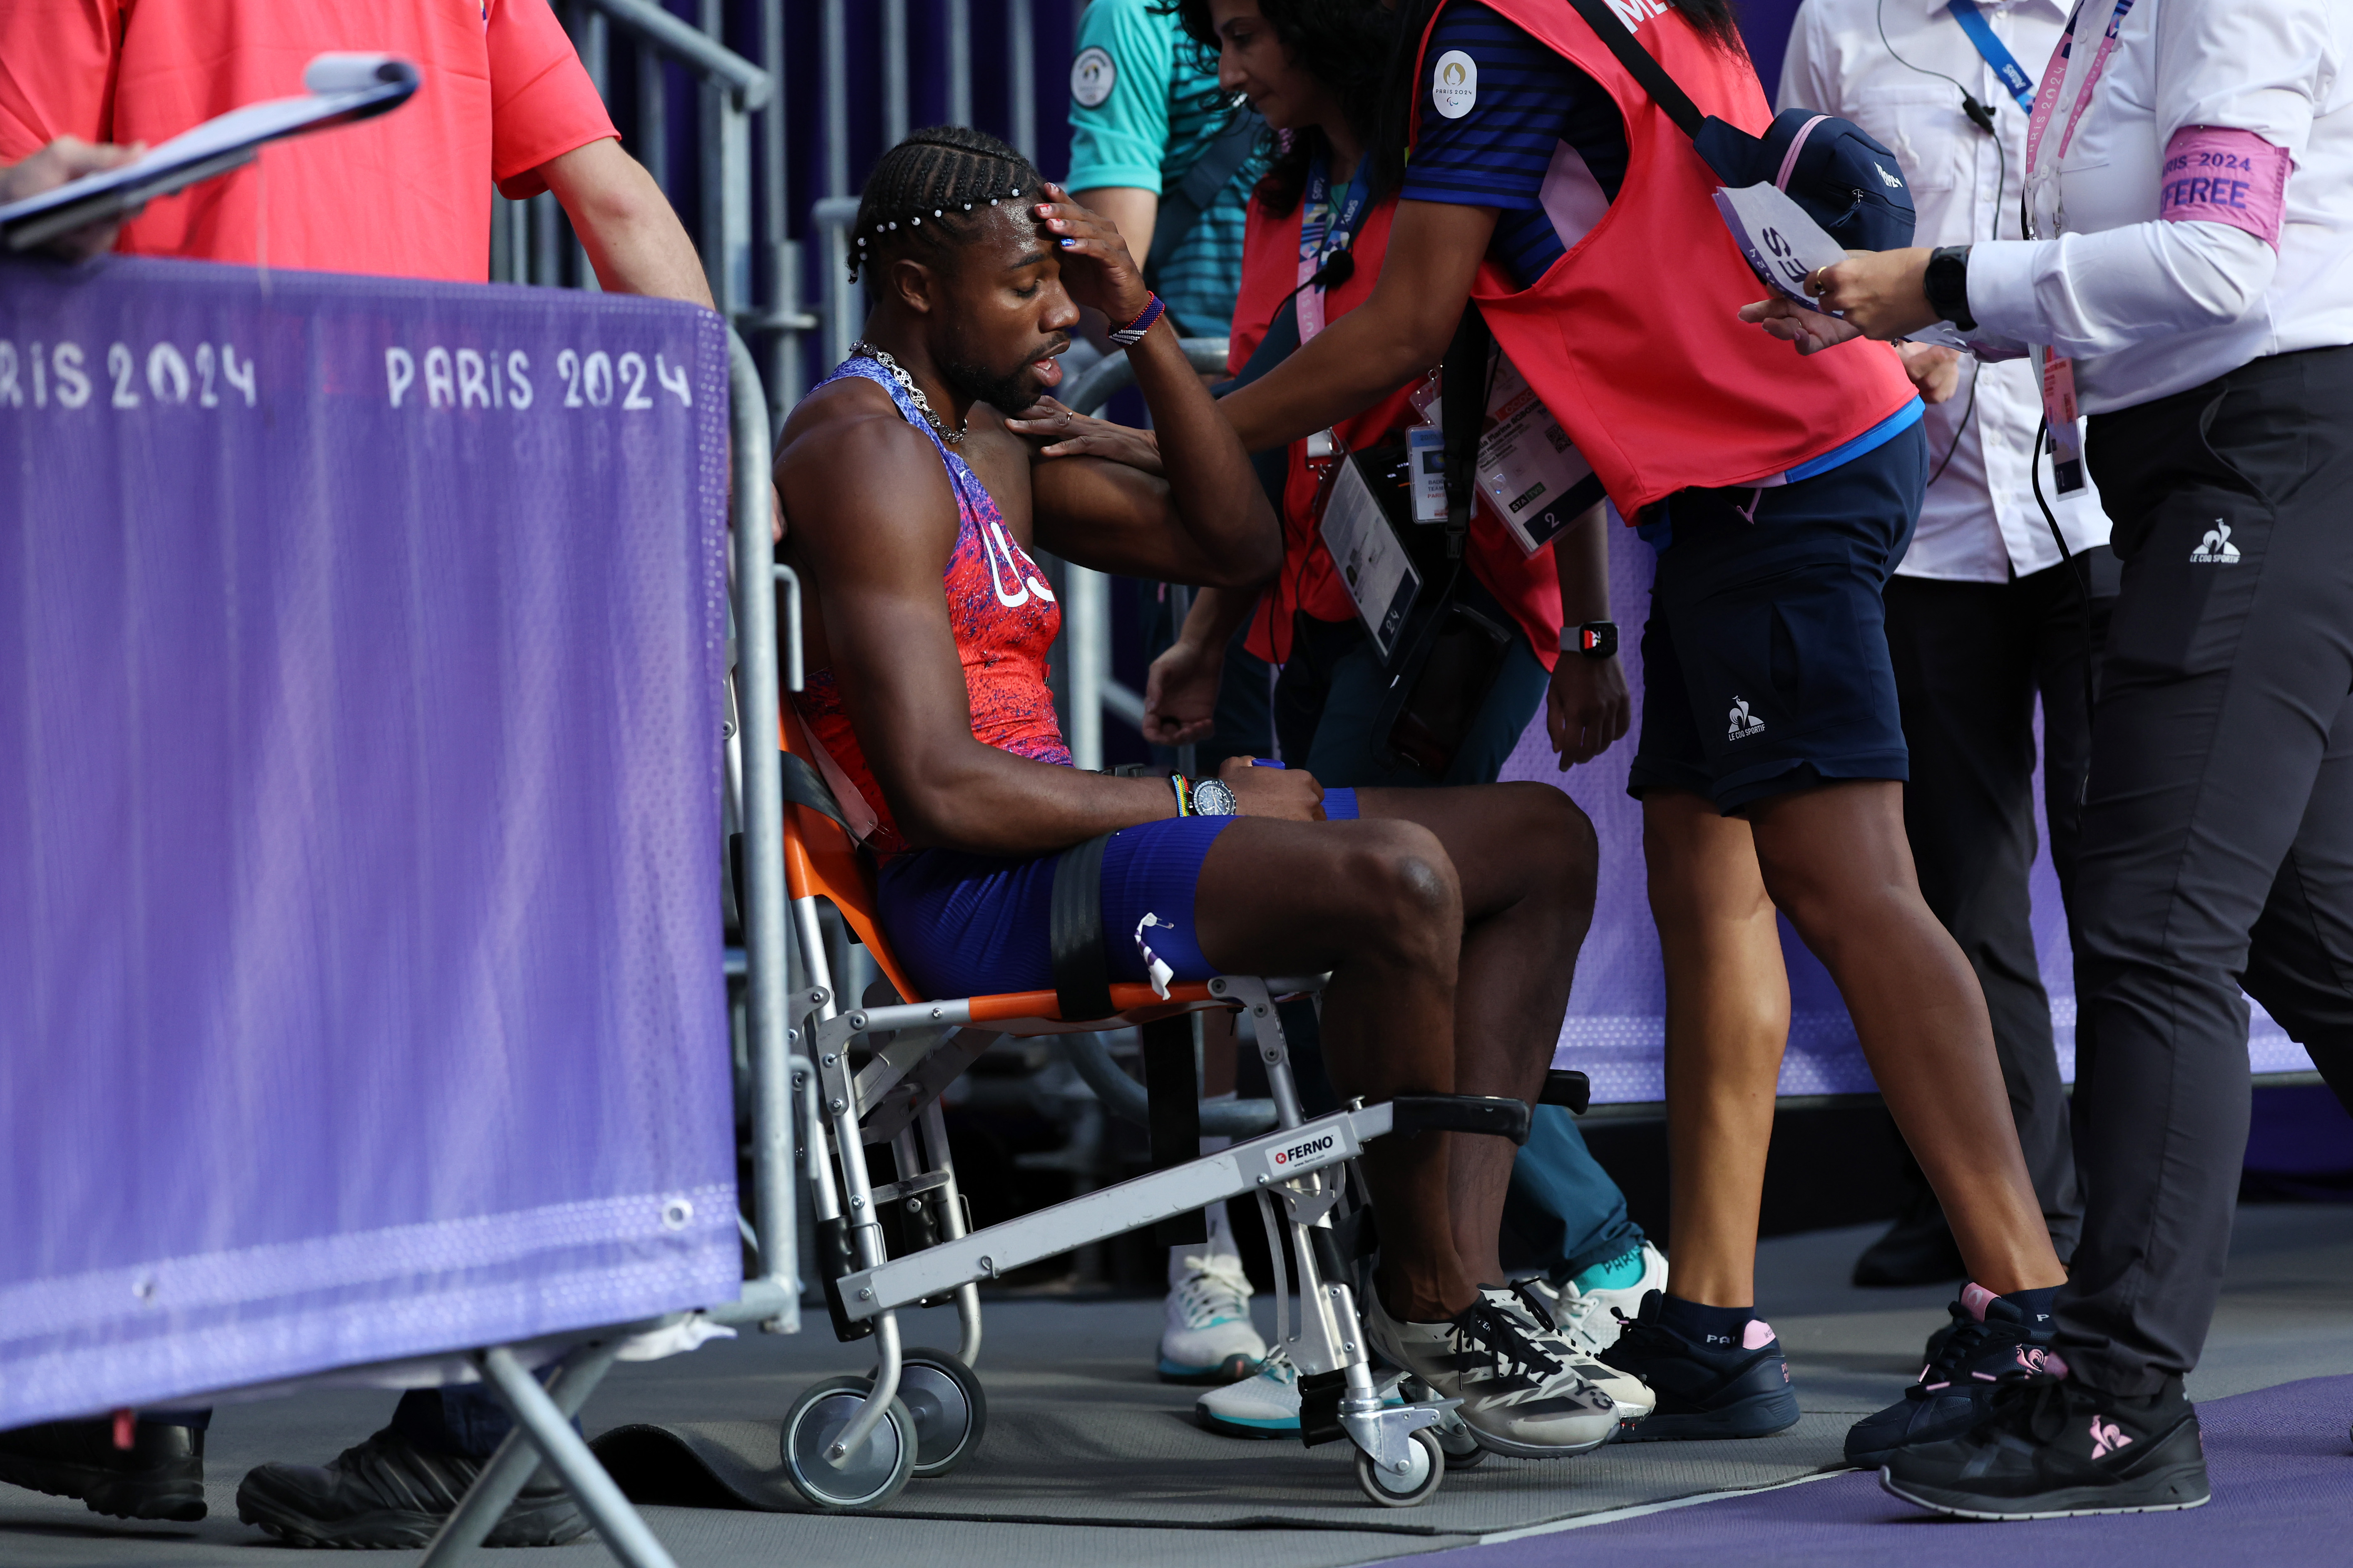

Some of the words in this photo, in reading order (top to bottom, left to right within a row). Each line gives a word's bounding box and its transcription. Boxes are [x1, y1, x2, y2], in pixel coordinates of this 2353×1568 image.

[2041, 66, 2065, 110] 2024
[2199, 152, 2251, 172] 2024
[107, 339, 257, 410] 2024
[556, 347, 693, 410] 2024
[1512, 498, 1527, 511] STA
[1545, 512, 1560, 528] 2
[2189, 554, 2198, 563] LE
[1728, 733, 1736, 741] LE
[1735, 730, 1745, 739] COQ
[1745, 724, 1765, 736] SPORTIF
[1287, 1136, 1333, 1162] FERNO
[1574, 1378, 1615, 1410] Y-3
